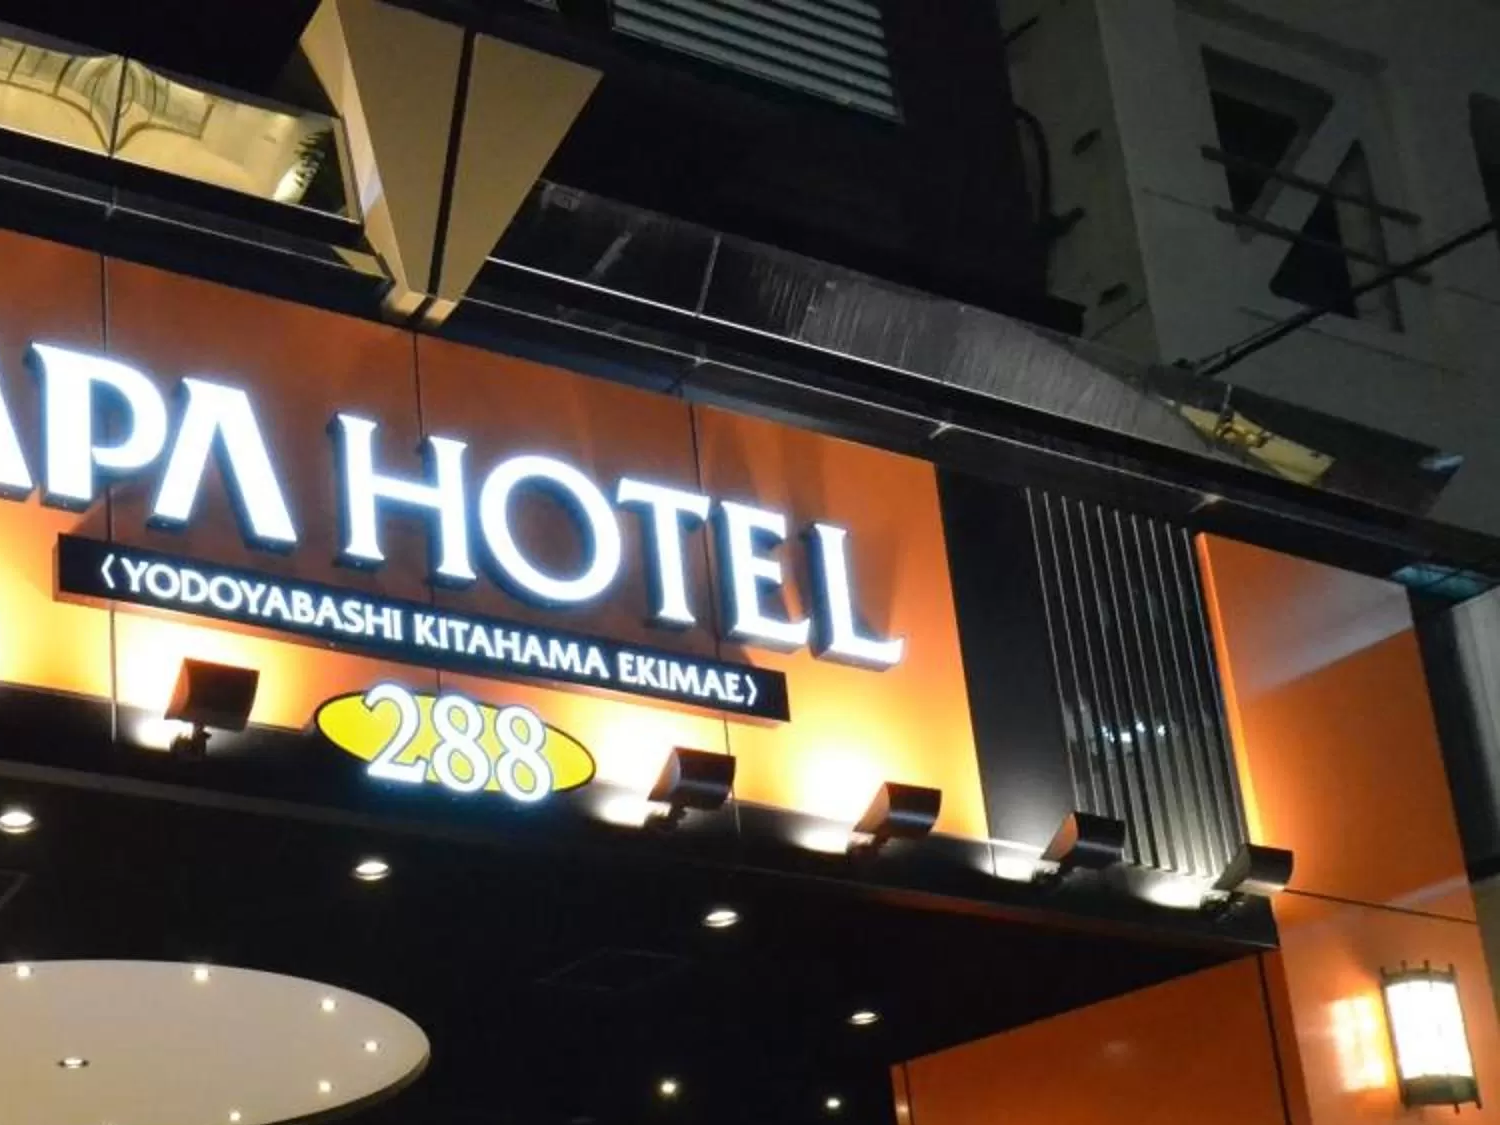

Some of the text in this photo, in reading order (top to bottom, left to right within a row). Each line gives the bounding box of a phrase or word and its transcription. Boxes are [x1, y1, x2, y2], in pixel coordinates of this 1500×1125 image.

[334, 413, 906, 666] HOTEL
[414, 613, 610, 680] KITAHAMA
[362, 682, 555, 802] 288
